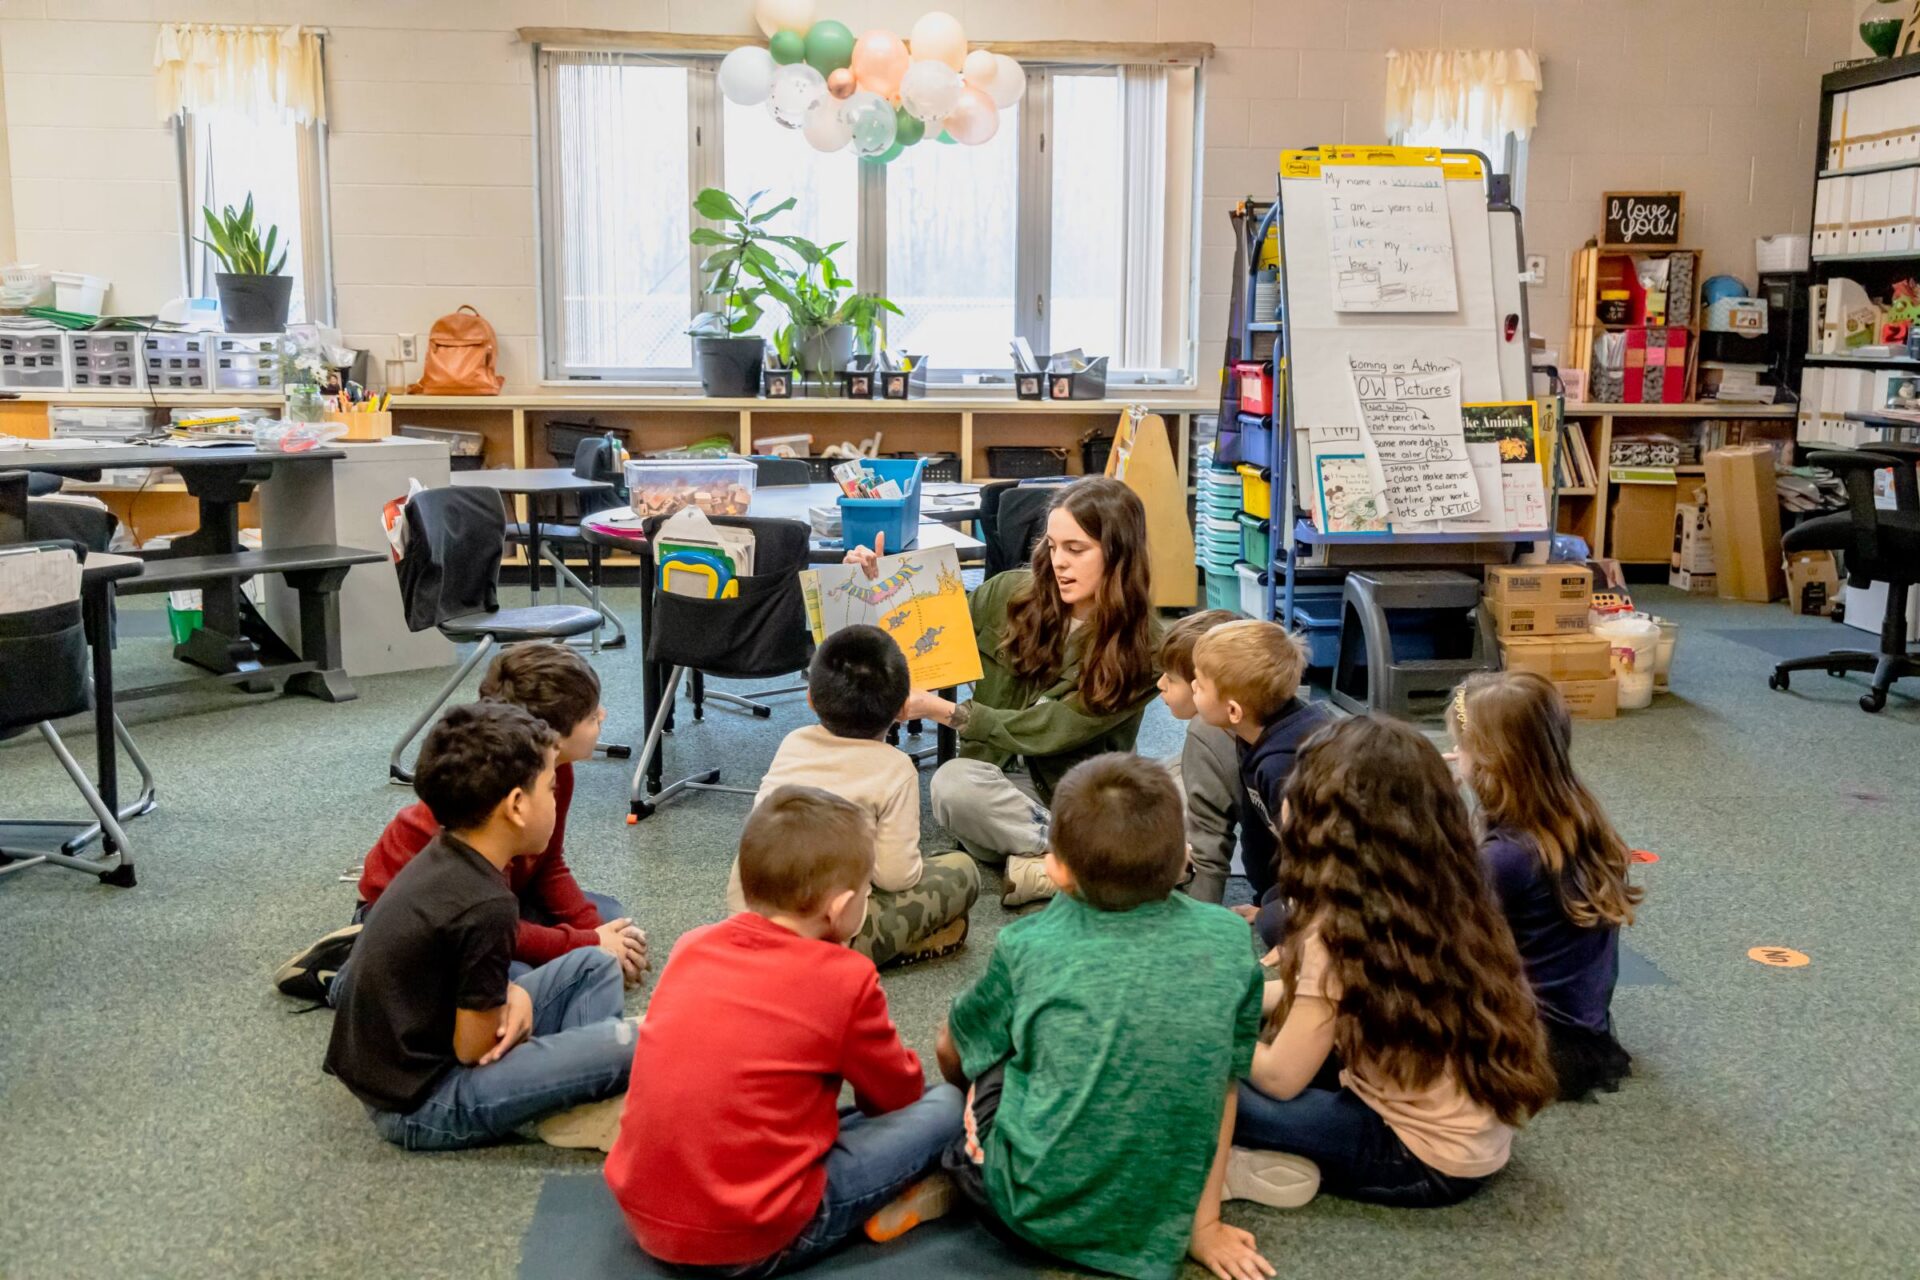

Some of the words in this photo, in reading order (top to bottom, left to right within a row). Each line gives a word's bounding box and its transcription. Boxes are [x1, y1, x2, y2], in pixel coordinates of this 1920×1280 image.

[1325, 172, 1340, 188] My
[1346, 178, 1371, 186] name
[1379, 178, 1388, 186] is
[1331, 197, 1343, 211] I
[1350, 202, 1366, 212] am
[1388, 202, 1411, 214] years
[1627, 198, 1670, 220] love
[1352, 215, 1373, 228] like
[1621, 212, 1677, 243] you!
[1384, 240, 1400, 256] my
[1412, 358, 1450, 372] Author
[1394, 376, 1451, 397] Pictures
[1393, 411, 1418, 423] pencil
[1482, 415, 1529, 429] Animals
[1409, 423, 1435, 431] details
[1419, 438, 1449, 448] details
[1401, 450, 1421, 458] color
[1419, 463, 1430, 471] list
[1422, 472, 1444, 480] make
[1445, 471, 1469, 480] sense
[1391, 486, 1401, 494] at
[1405, 485, 1421, 493] least
[1434, 482, 1457, 490] colors
[1394, 495, 1425, 504] outline
[1430, 494, 1445, 505] your
[1450, 491, 1470, 500] work
[1397, 506, 1417, 517] lots
[1424, 504, 1435, 516] of
[1440, 499, 1480, 516] DETAILS
